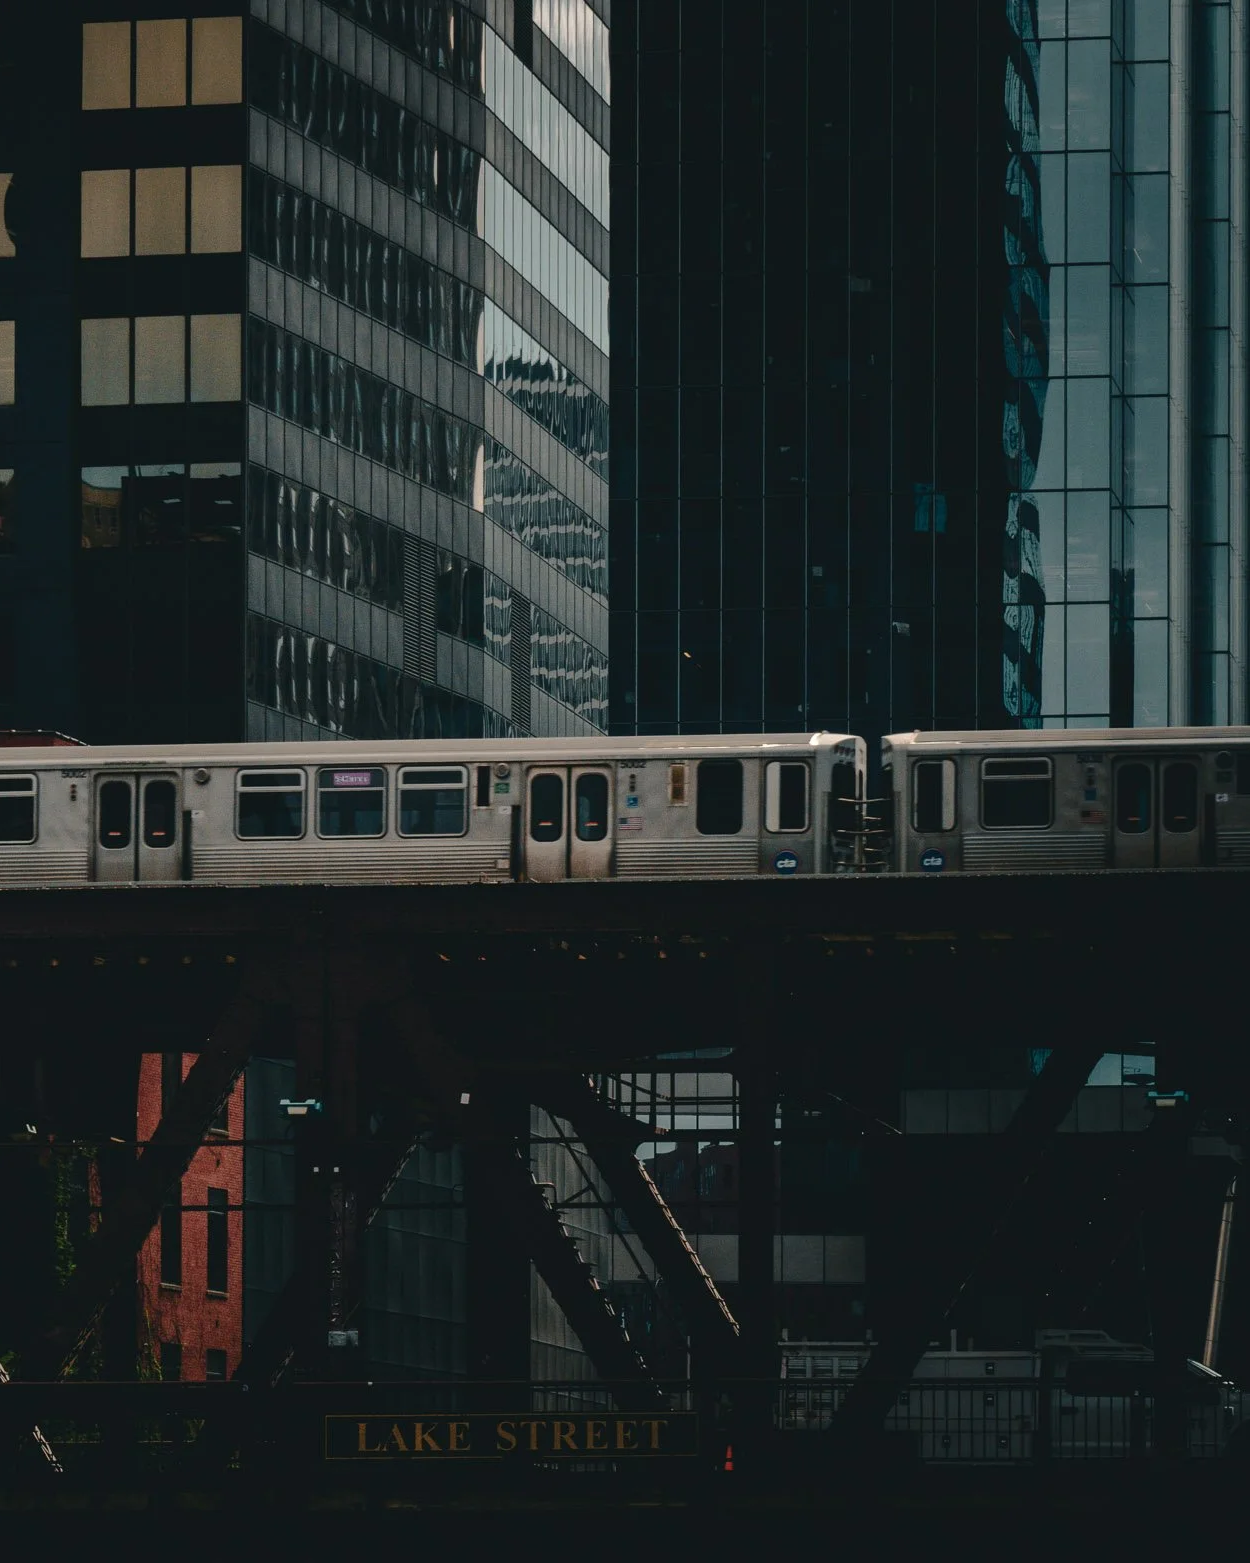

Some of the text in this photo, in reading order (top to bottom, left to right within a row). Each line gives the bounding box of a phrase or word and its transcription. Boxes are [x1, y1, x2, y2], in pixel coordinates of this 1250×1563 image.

[776, 859, 797, 868] cta
[923, 857, 943, 866] cta
[357, 1420, 669, 1452] LAKE STREET
